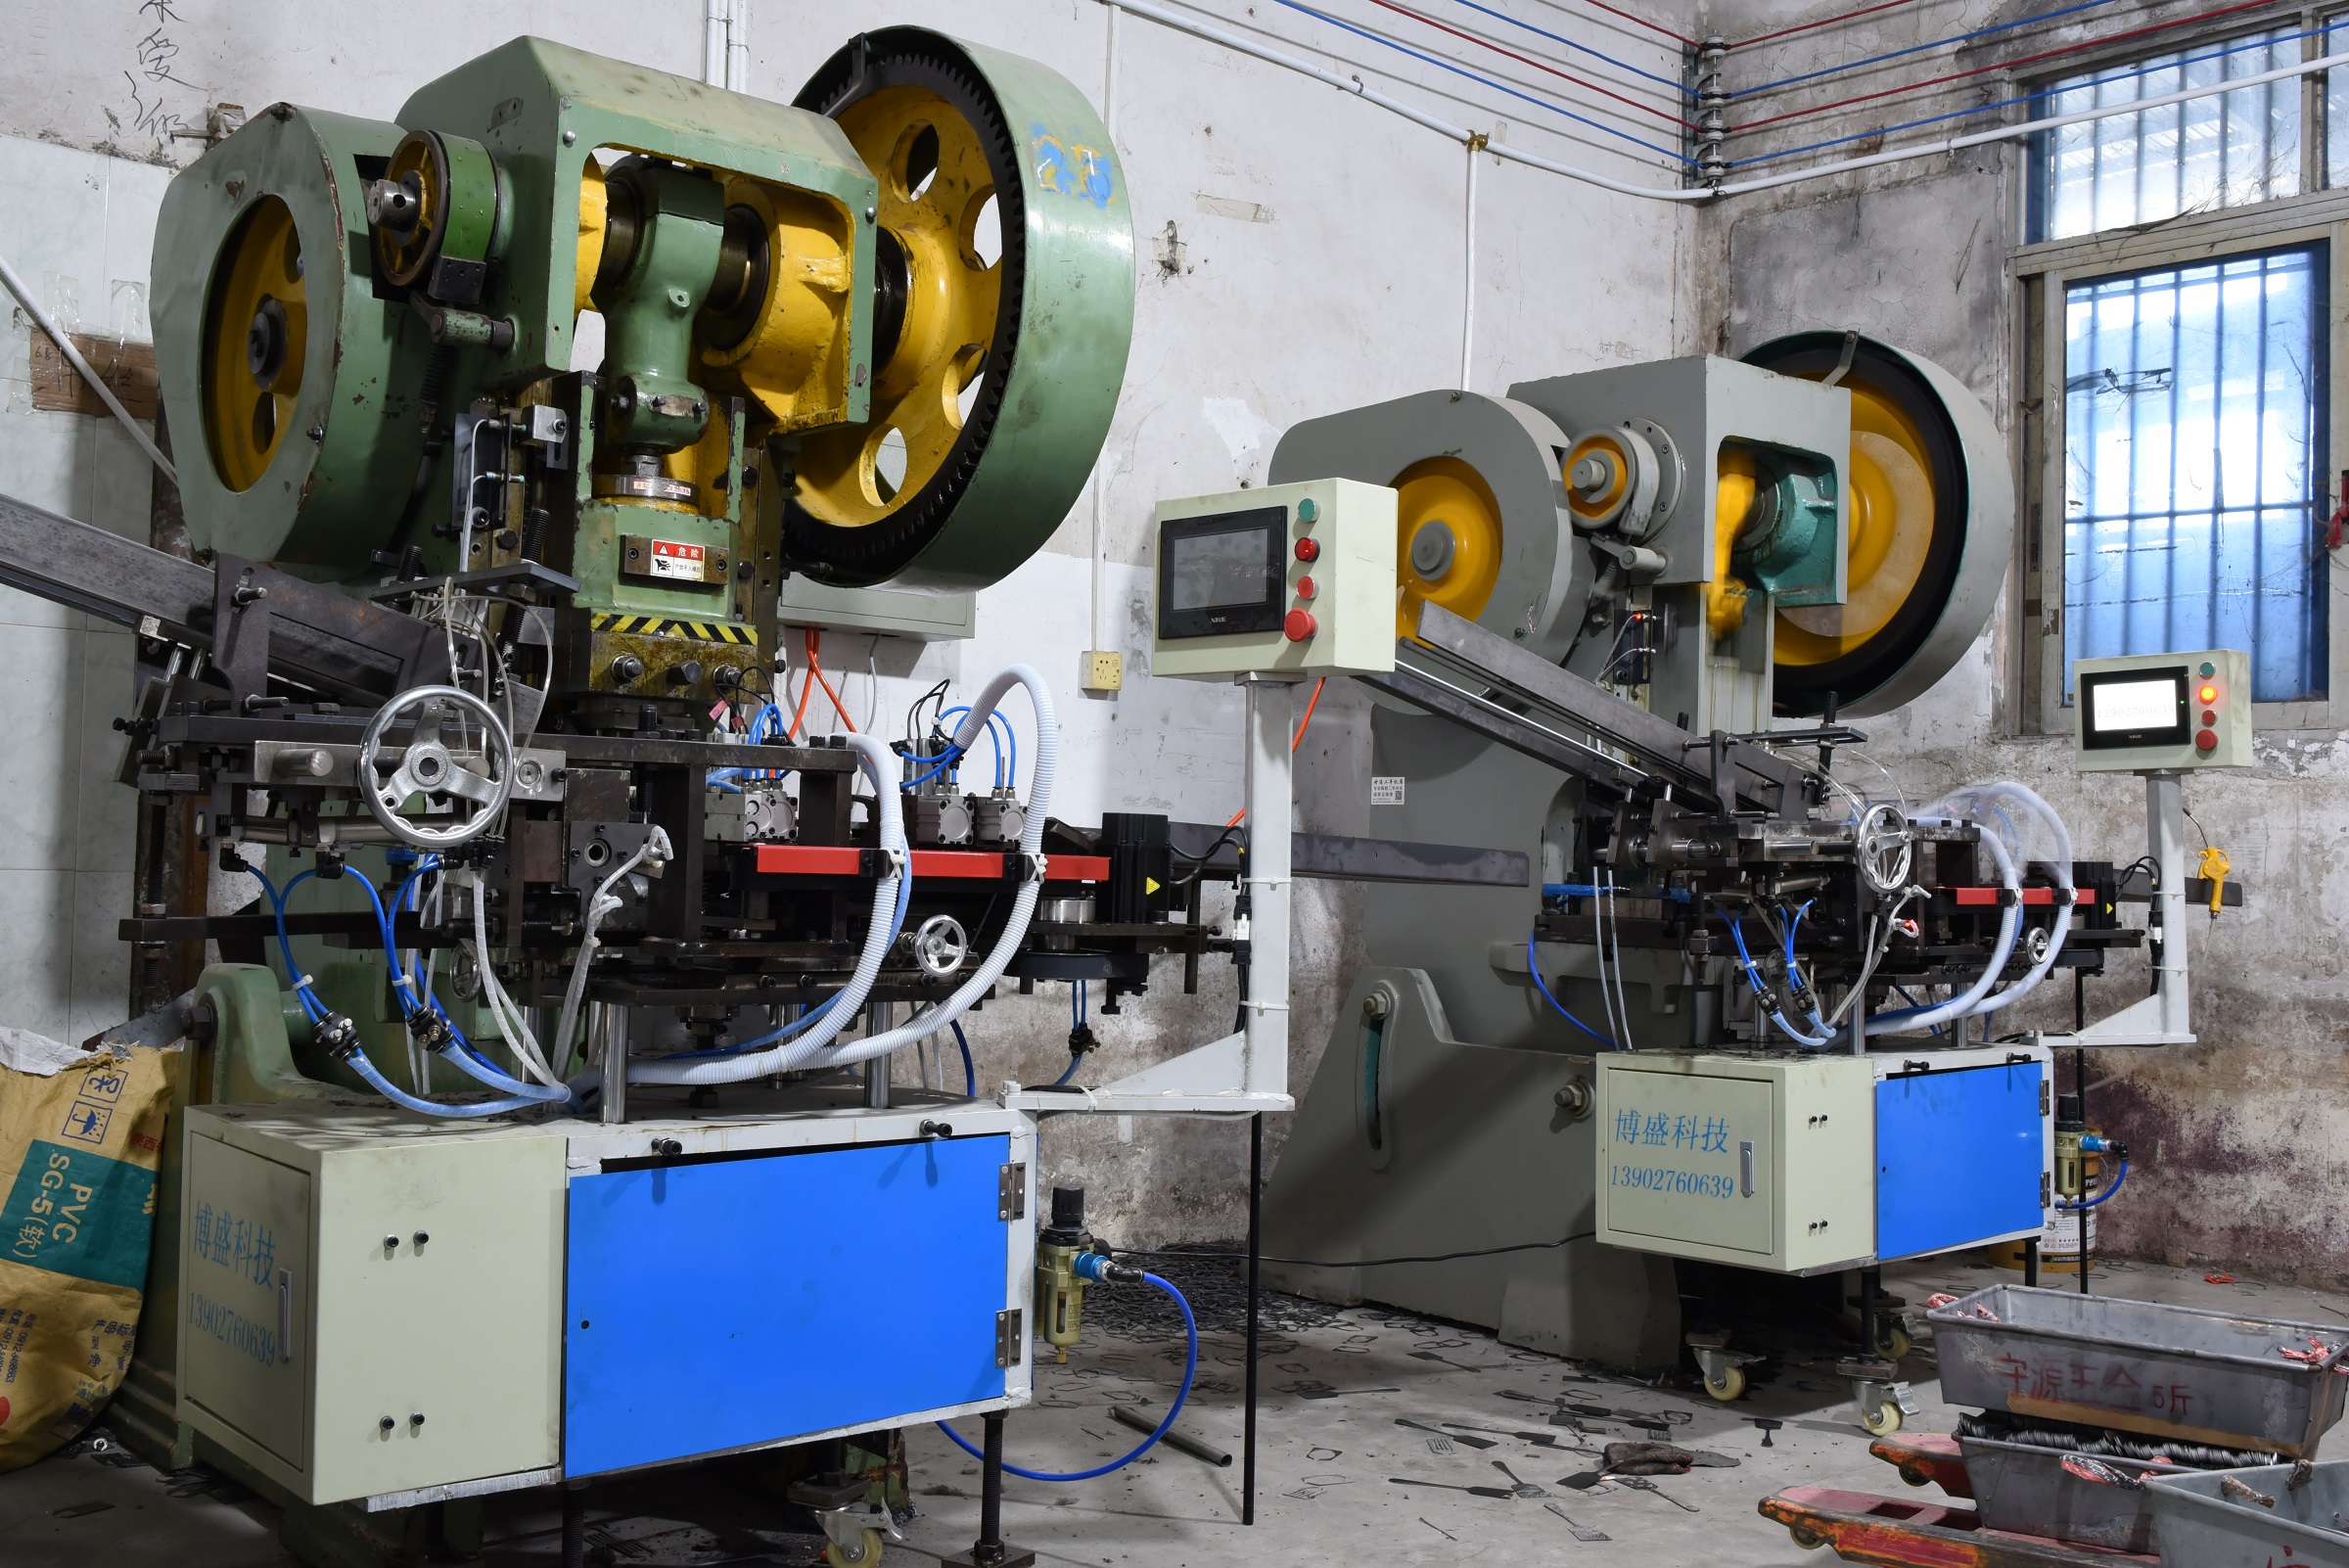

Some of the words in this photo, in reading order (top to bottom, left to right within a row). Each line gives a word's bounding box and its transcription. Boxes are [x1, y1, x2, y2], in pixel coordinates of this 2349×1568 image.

[678, 546, 699, 558] 危险
[2096, 704, 2176, 719] 13902760639
[1615, 1108, 1730, 1154] 博盛科技
[1611, 1165, 1734, 1199] 13902760639
[52, 1182, 94, 1243] PVC
[194, 1199, 276, 1290] 博盛科技
[189, 1292, 276, 1367] 13902760639
